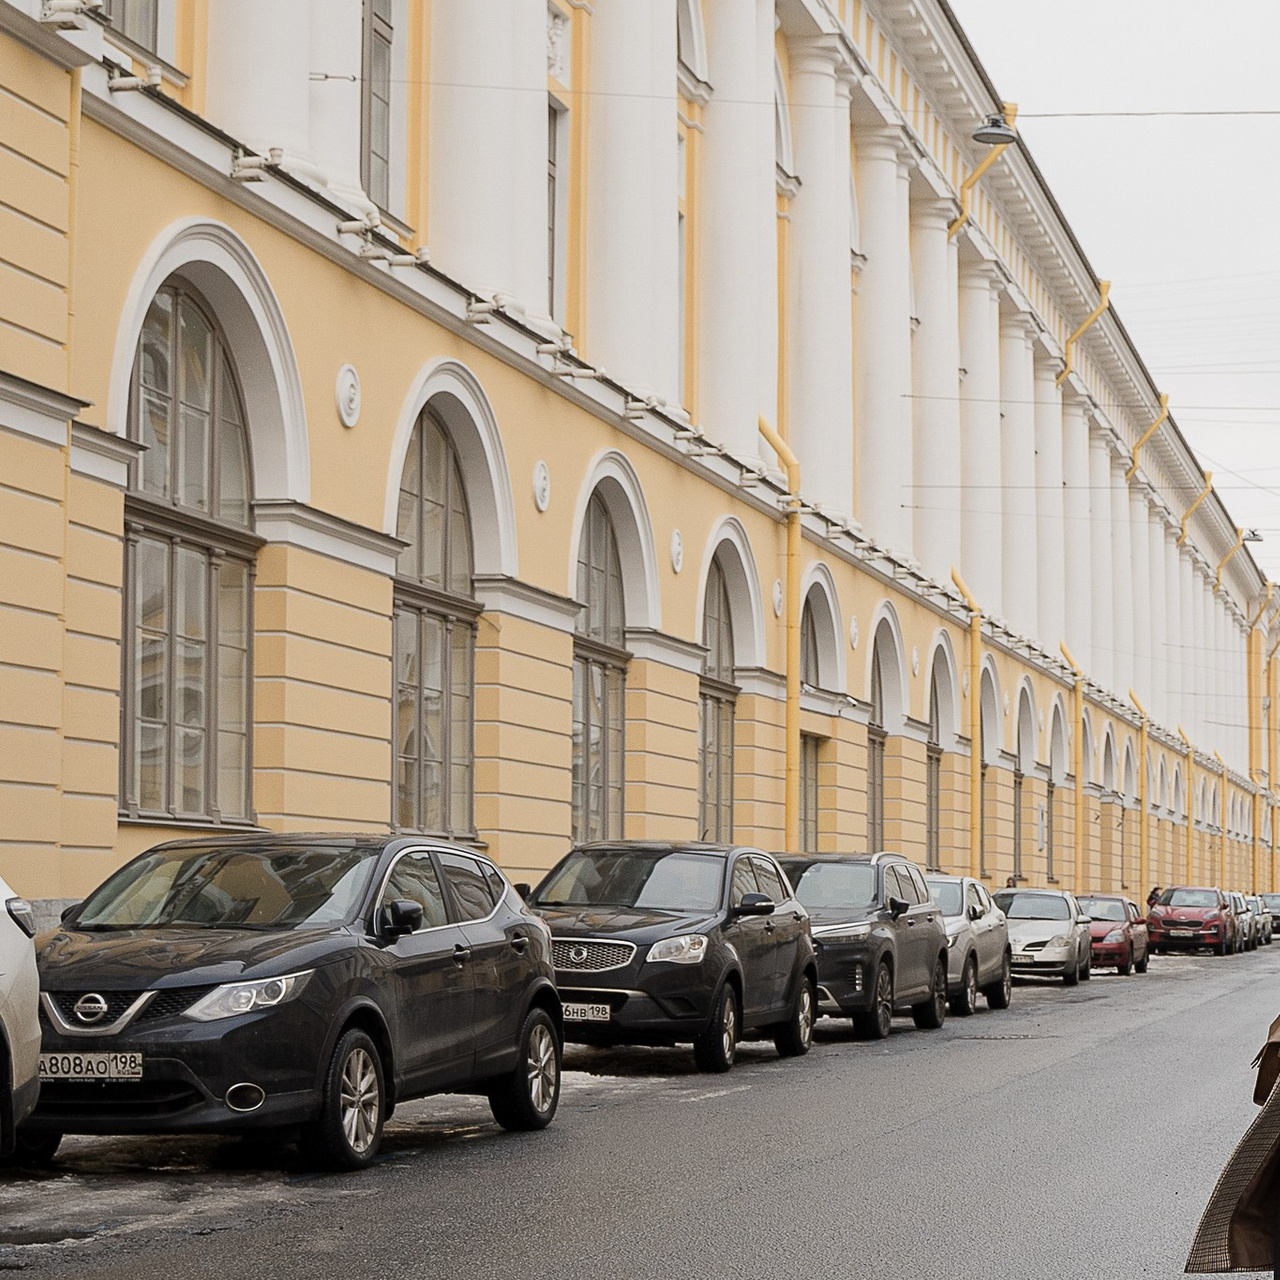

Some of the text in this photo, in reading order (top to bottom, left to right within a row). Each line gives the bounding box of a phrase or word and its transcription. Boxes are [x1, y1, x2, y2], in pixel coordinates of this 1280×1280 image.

[589, 1006, 607, 1016] 198
[39, 1055, 137, 1075] А808АО 198
